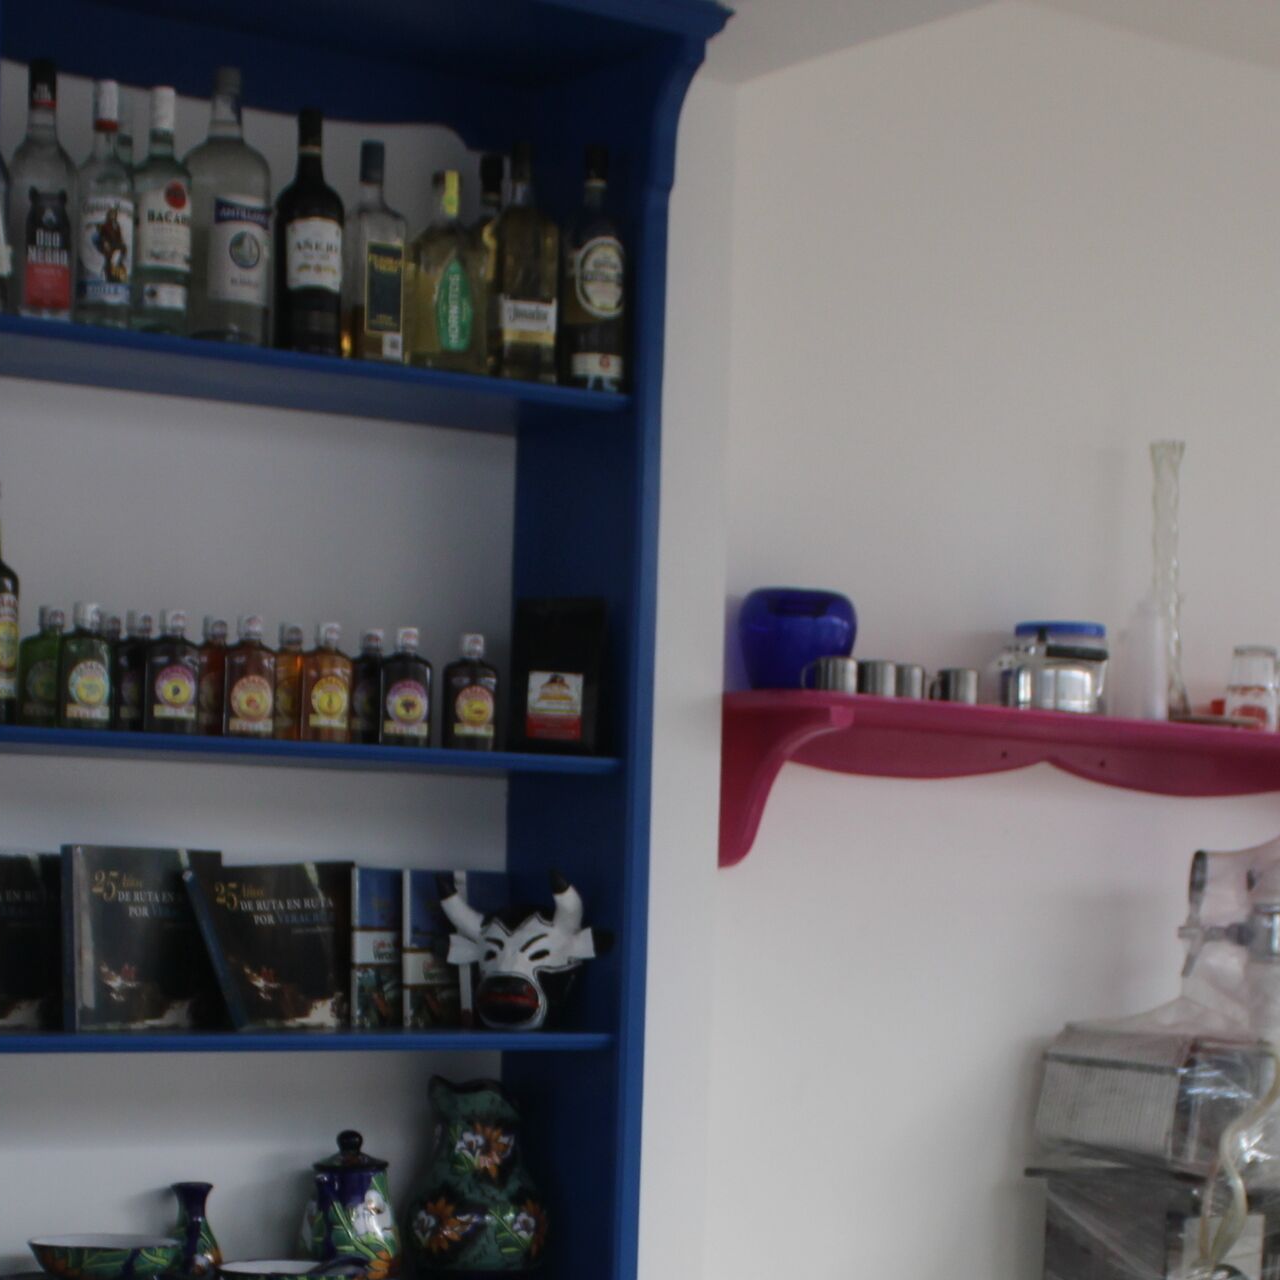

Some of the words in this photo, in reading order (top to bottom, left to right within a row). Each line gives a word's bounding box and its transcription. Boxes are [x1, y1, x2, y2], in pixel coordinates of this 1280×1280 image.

[91, 870, 117, 903] 25
[215, 881, 240, 912] 25
[128, 905, 150, 919] POR
[240, 900, 254, 912] DE
[256, 899, 285, 911] RUTA
[287, 898, 301, 910] EN
[304, 897, 334, 910] RUTA
[253, 913, 276, 926] POR
